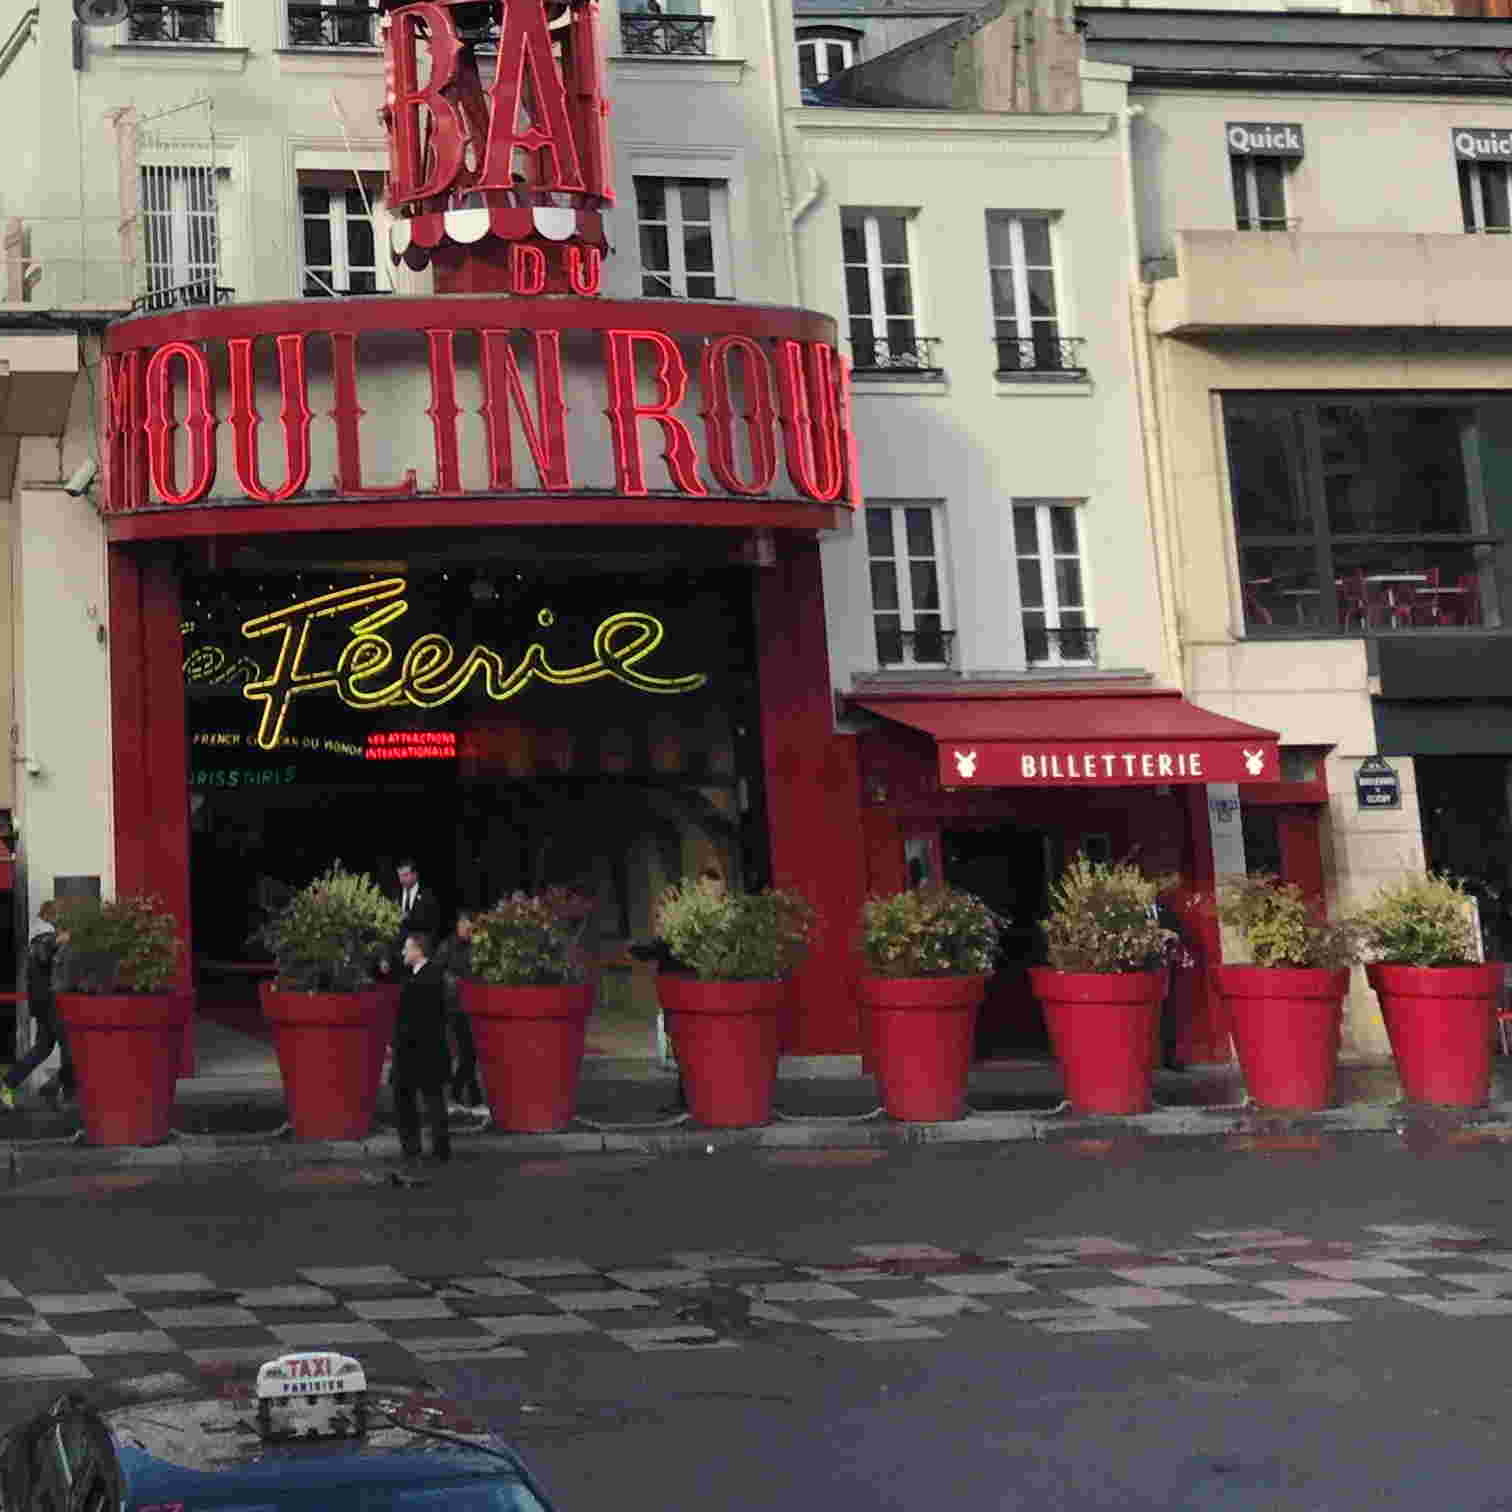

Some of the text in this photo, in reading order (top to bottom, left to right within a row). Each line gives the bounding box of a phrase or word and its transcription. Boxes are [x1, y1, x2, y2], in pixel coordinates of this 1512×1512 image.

[1228, 126, 1300, 152] Quick
[511, 242, 601, 296] DU
[101, 328, 573, 510] MOULIN
[1020, 751, 1204, 779] BILLETTERIE
[285, 1358, 333, 1377] TAXI
